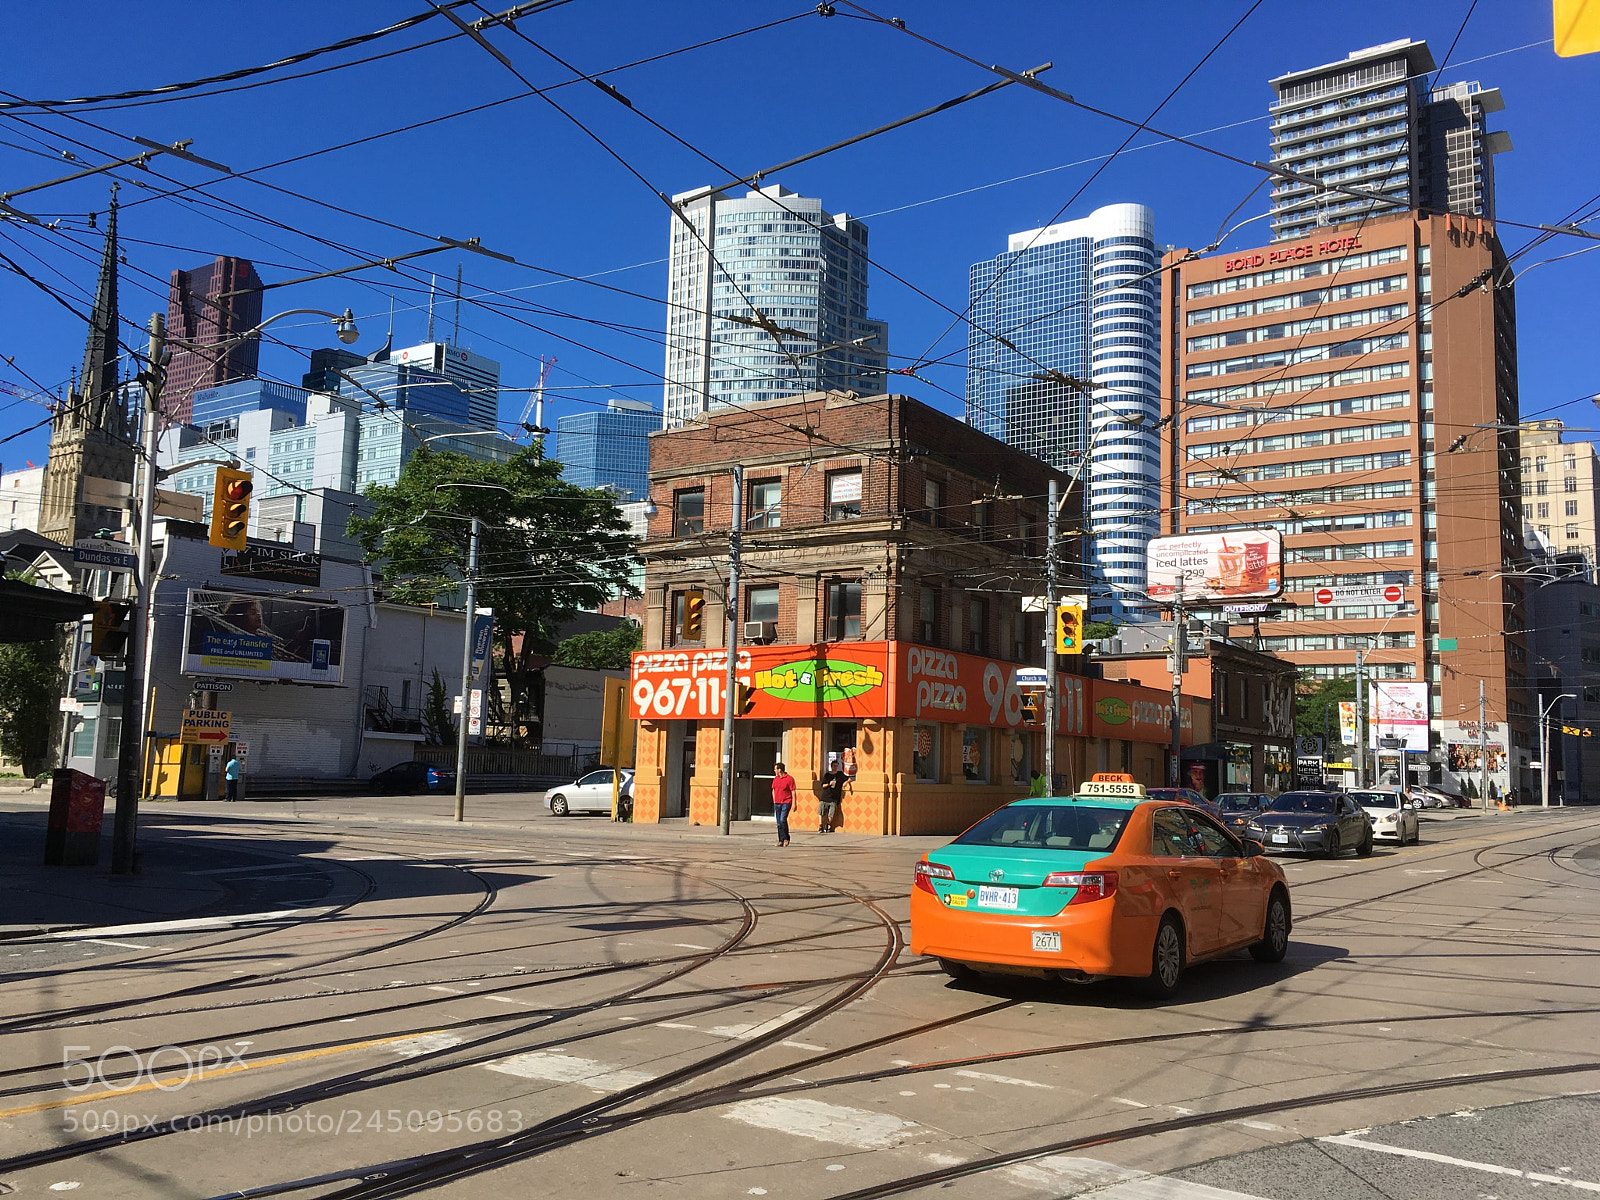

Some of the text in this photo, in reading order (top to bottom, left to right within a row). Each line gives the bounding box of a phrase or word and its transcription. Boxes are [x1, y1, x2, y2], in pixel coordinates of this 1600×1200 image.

[1225, 236, 1362, 272] BOND PLACE HOTEL
[446, 348, 460, 358] BMO
[1169, 541, 1202, 550] perfectly
[79, 551, 111, 562] Dundas
[123, 556, 128, 565] E
[1156, 548, 1208, 558] uncomplicated
[1156, 557, 1208, 568] iced lattes
[1246, 559, 1266, 570] latte
[1360, 588, 1381, 596] ENTER
[1224, 604, 1265, 612] OUTFRONT
[207, 635, 221, 645] The
[239, 639, 269, 649] Transfer
[234, 650, 264, 658] UNLIMITED
[633, 653, 689, 681] pizza
[907, 646, 958, 684] pizza
[755, 665, 884, 690] Hot & Fresh
[196, 683, 231, 691] PATTISON
[916, 680, 967, 717] pizza
[188, 710, 228, 720] PUBLIC
[1132, 700, 1164, 730] pizza
[183, 719, 230, 729] PARKING
[1458, 720, 1497, 729] BOND PACE
[1298, 767, 1319, 775] HERE
[1300, 776, 1320, 785] PARK
[1087, 784, 1135, 794] 751-5555
[1035, 936, 1057, 948] 2671
